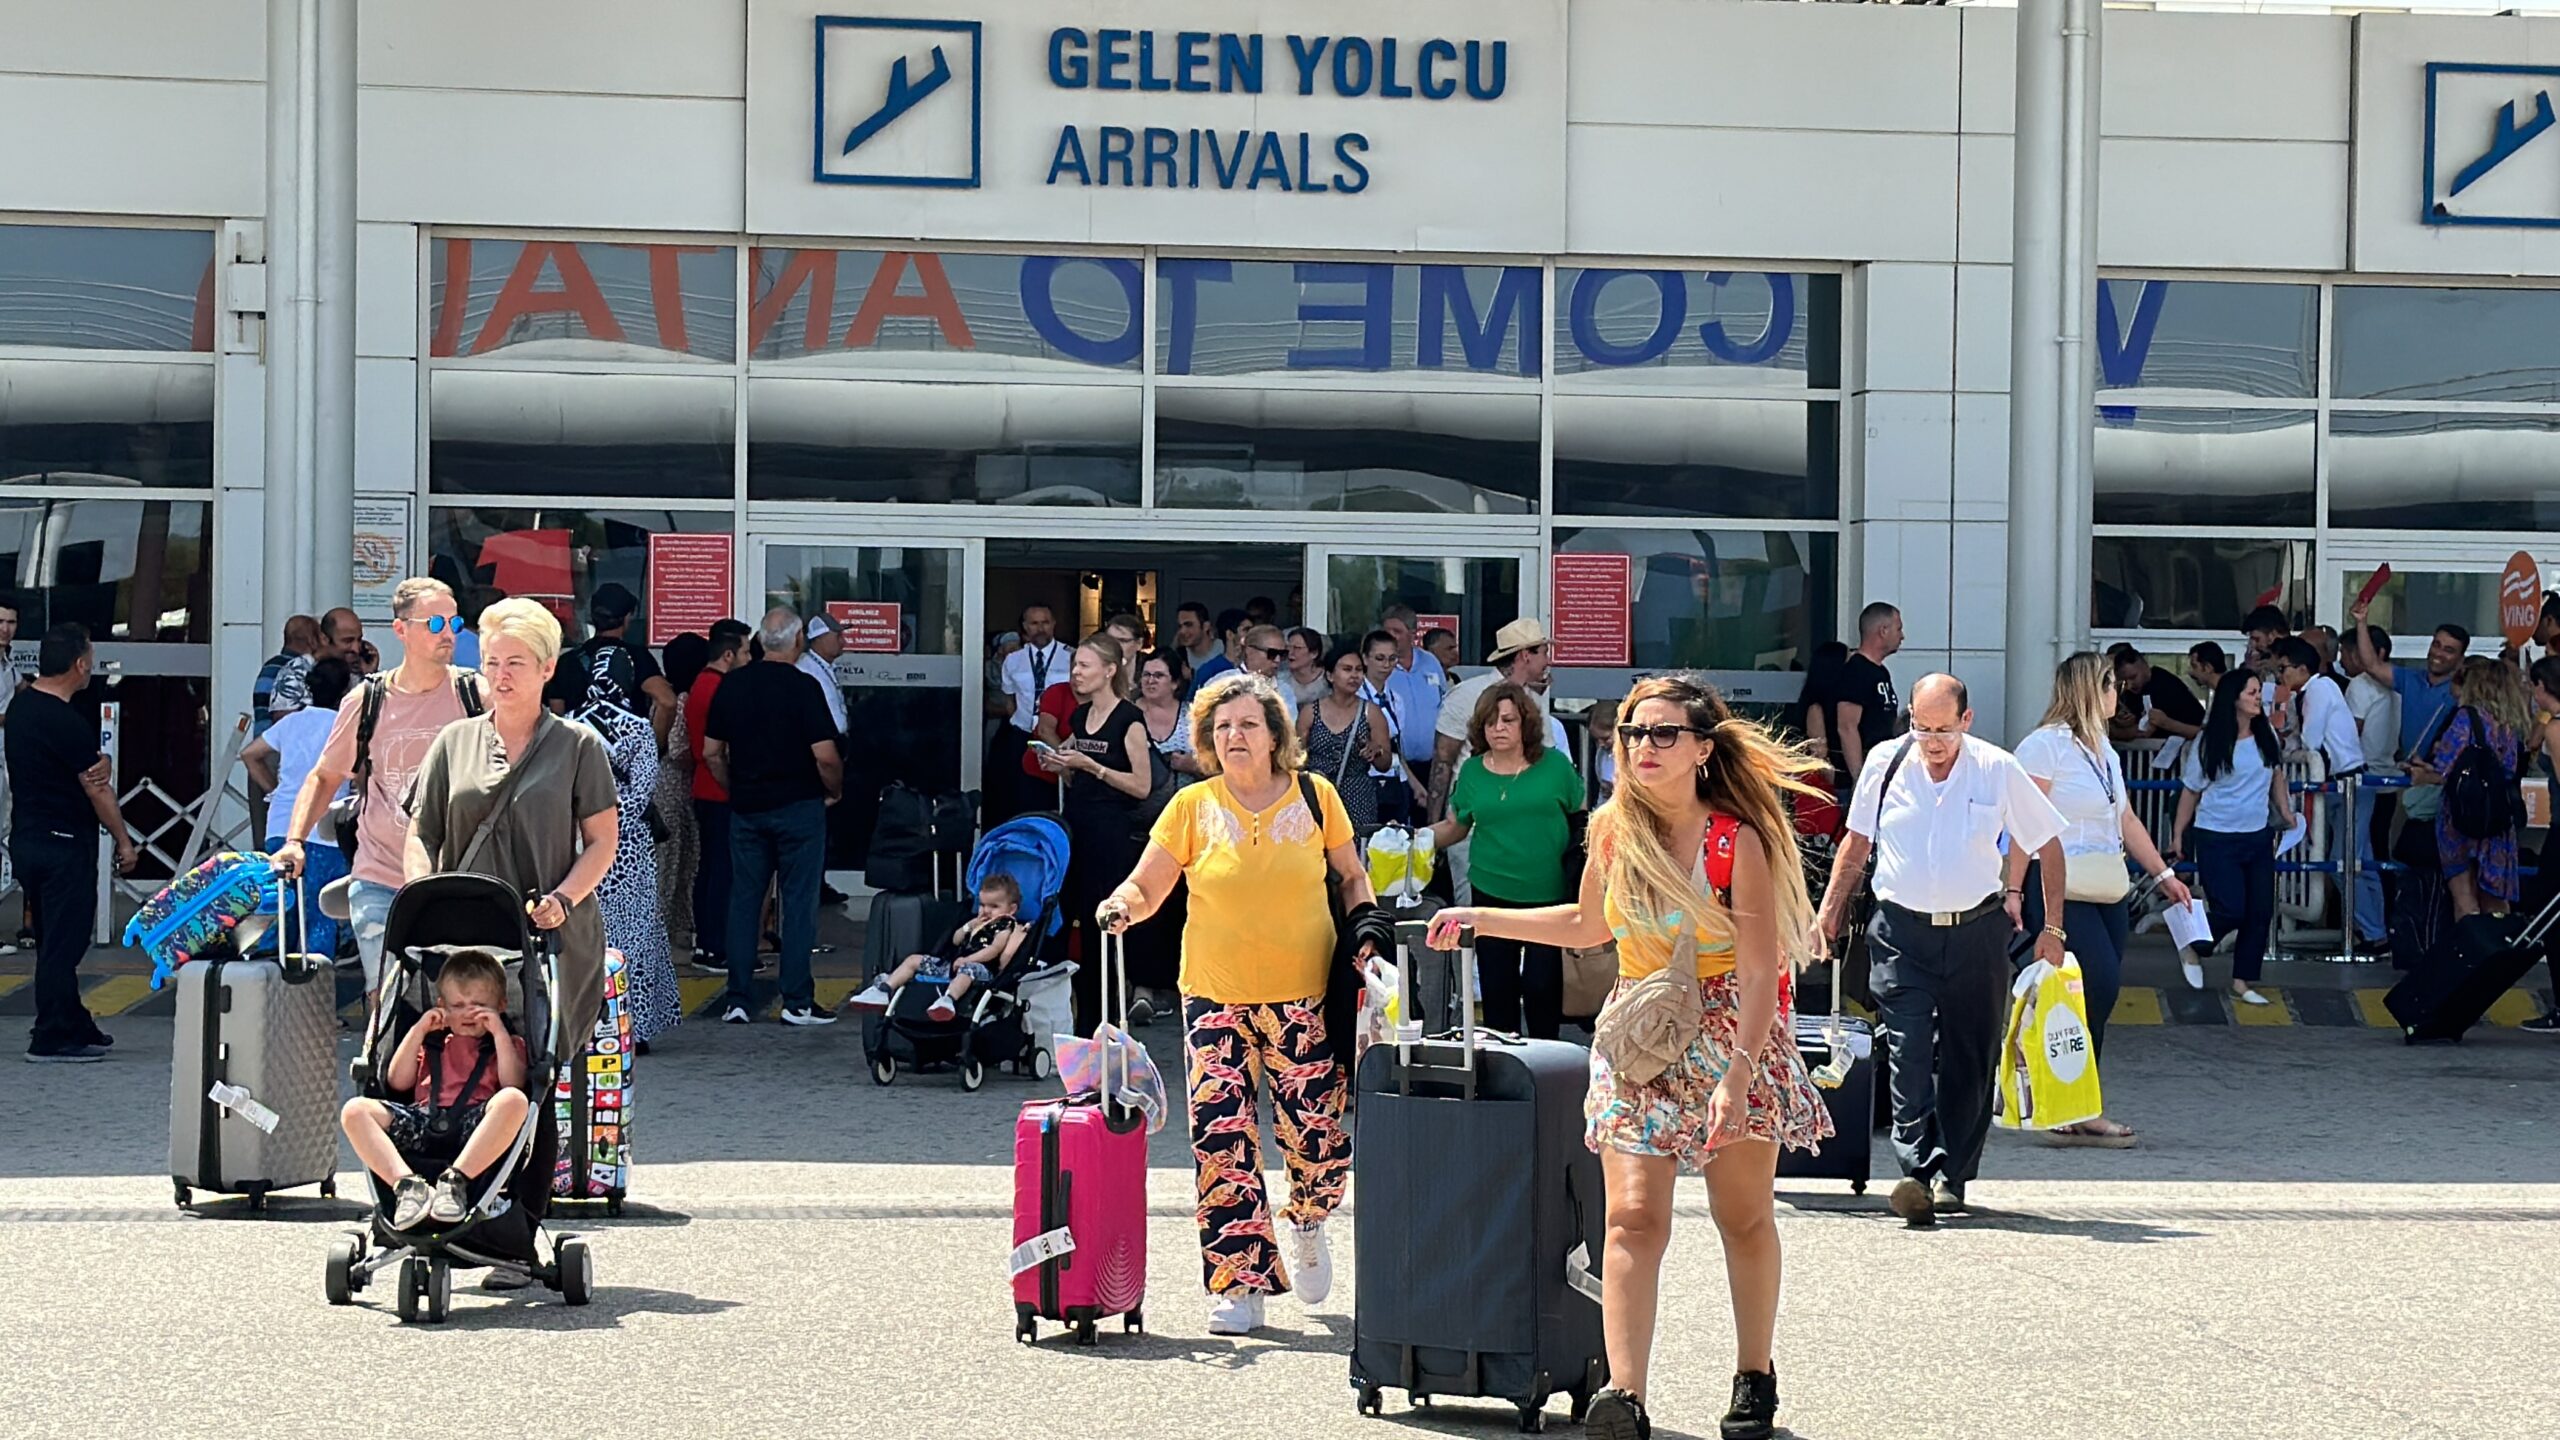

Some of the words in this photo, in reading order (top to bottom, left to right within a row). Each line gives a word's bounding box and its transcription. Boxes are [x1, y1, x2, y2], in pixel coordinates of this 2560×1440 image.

[1048, 27, 1263, 94] GELEN
[1286, 35, 1507, 100] YOLCU
[1046, 125, 1370, 193] ARRIVALS
[2503, 604, 2534, 626] VING
[2064, 1026, 2081, 1037] FREE
[603, 1058, 616, 1068] P
